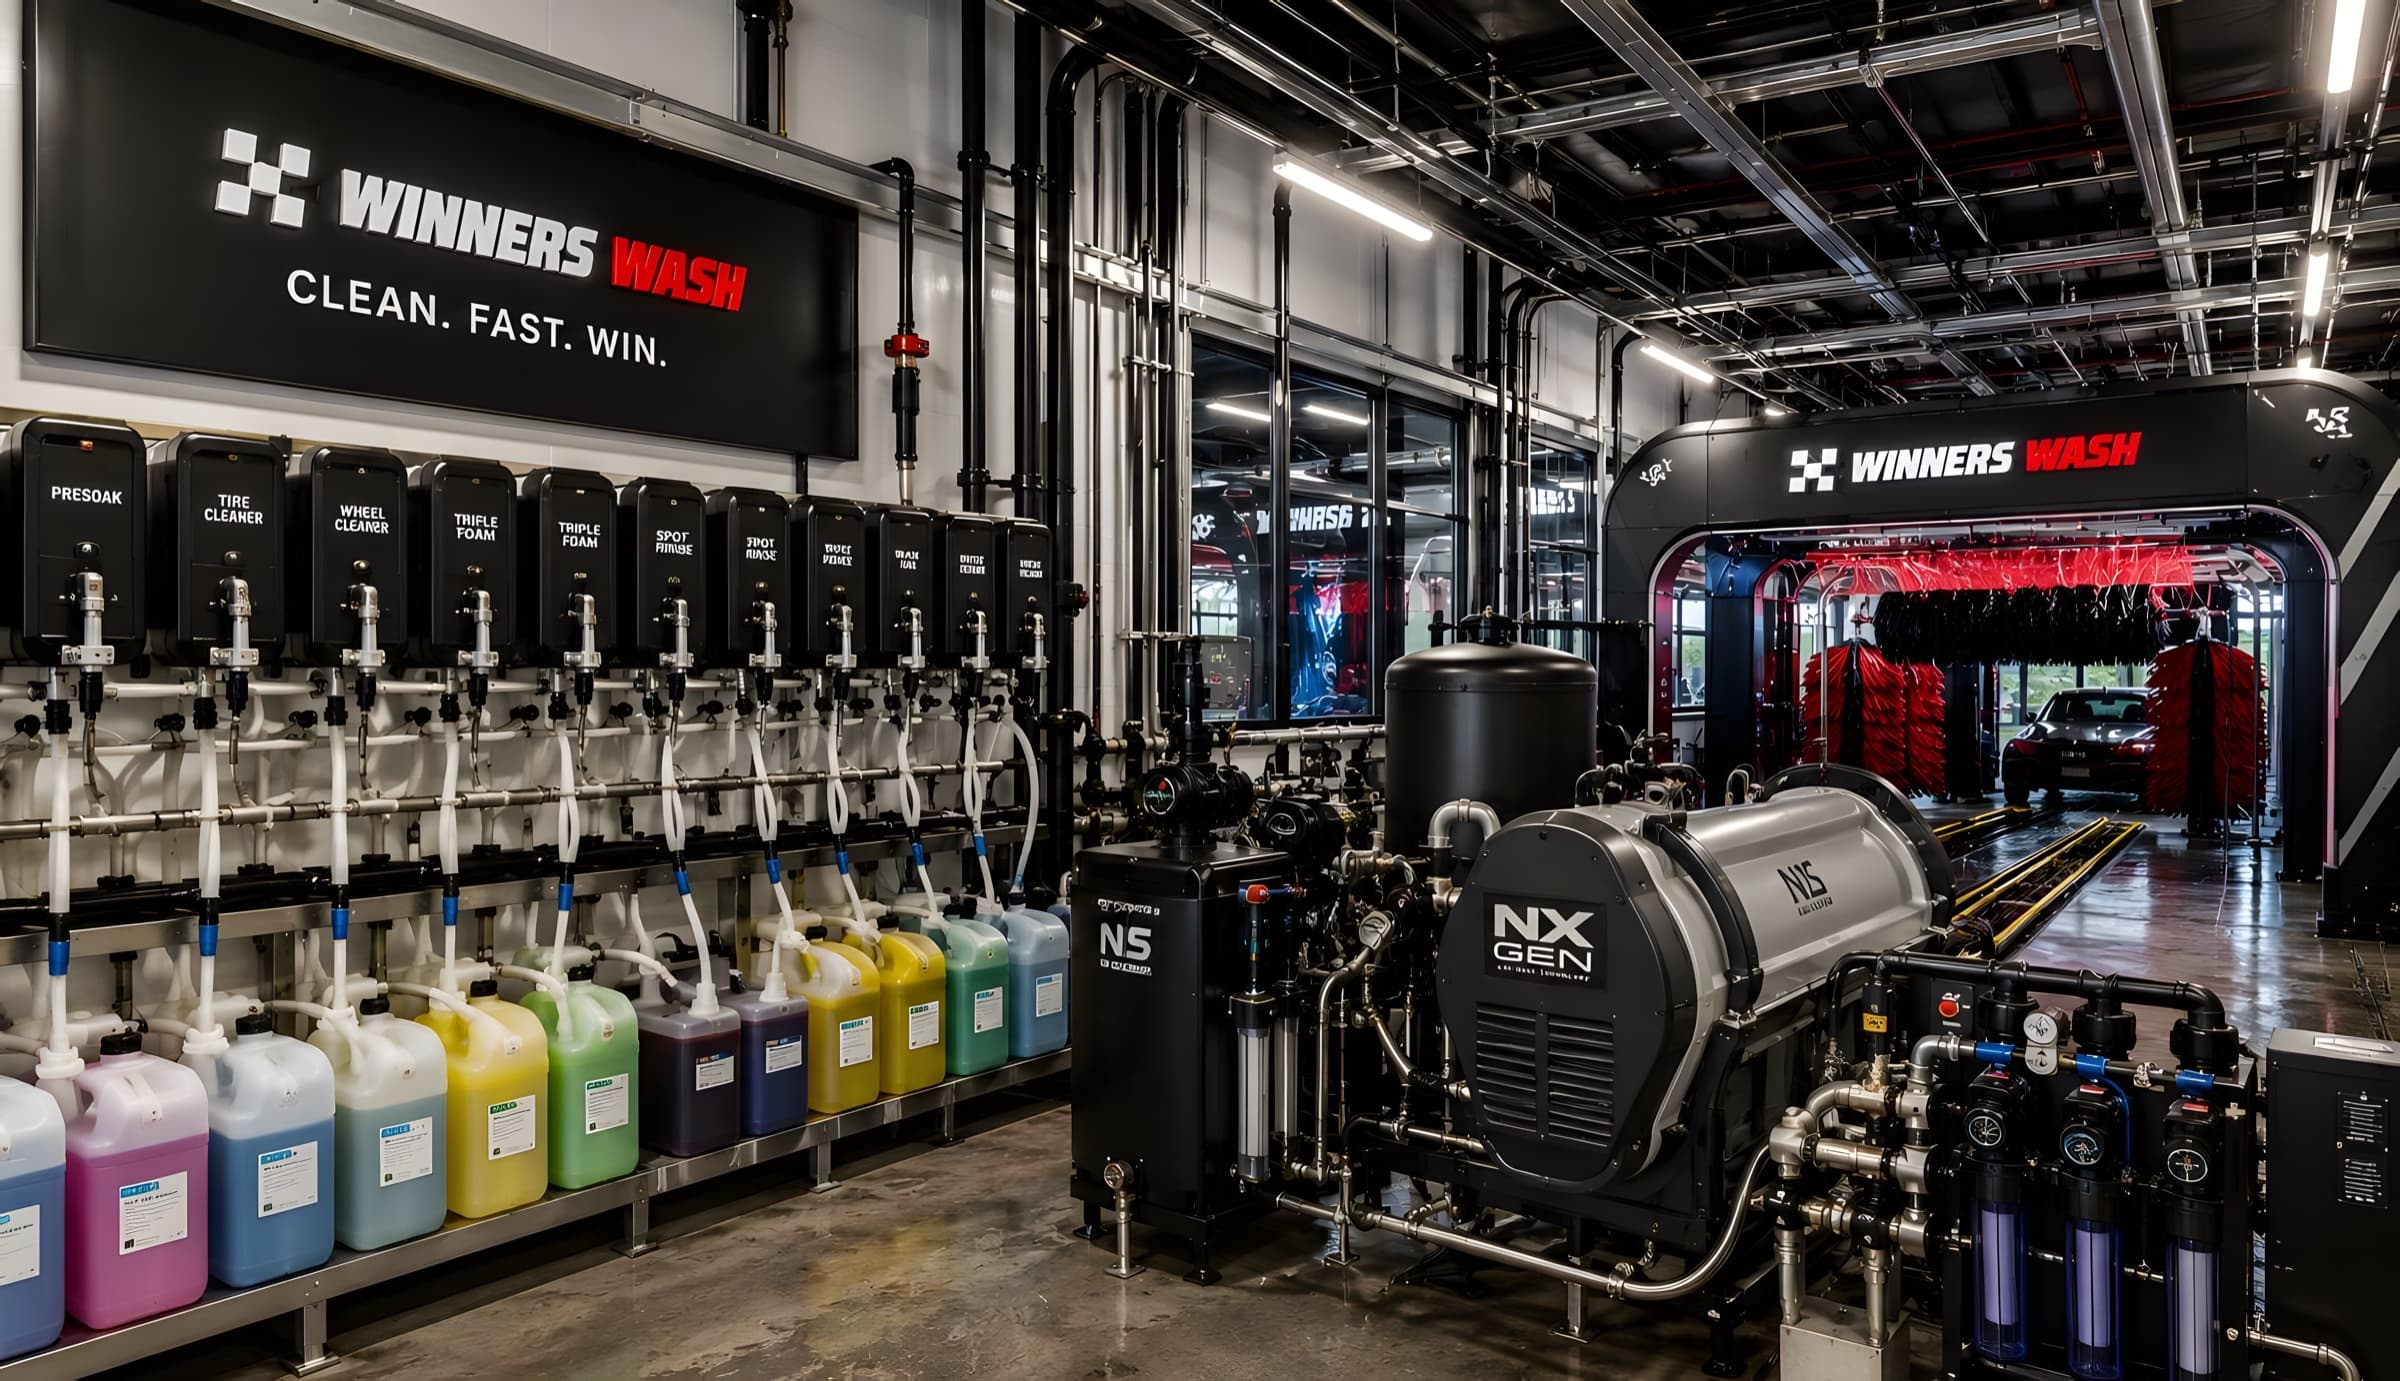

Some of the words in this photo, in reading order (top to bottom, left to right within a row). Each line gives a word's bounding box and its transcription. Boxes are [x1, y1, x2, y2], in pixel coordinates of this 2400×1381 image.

[339, 168, 599, 279] WINNERS
[611, 236, 747, 312] WASH
[287, 270, 450, 329] CLEAN.
[470, 303, 572, 351] FAST.
[587, 325, 667, 367] WIN.
[1852, 441, 2016, 483] WINNERS
[2026, 431, 2142, 472] WASH
[51, 486, 122, 505] PRESOAK
[217, 494, 250, 509] TIRE
[340, 504, 386, 520] WHEEL
[456, 527, 496, 541] FOAM
[562, 535, 598, 549] FOAM
[656, 530, 690, 543] SPOT
[1494, 903, 1595, 949] NX
[1493, 941, 1593, 973] GEN
